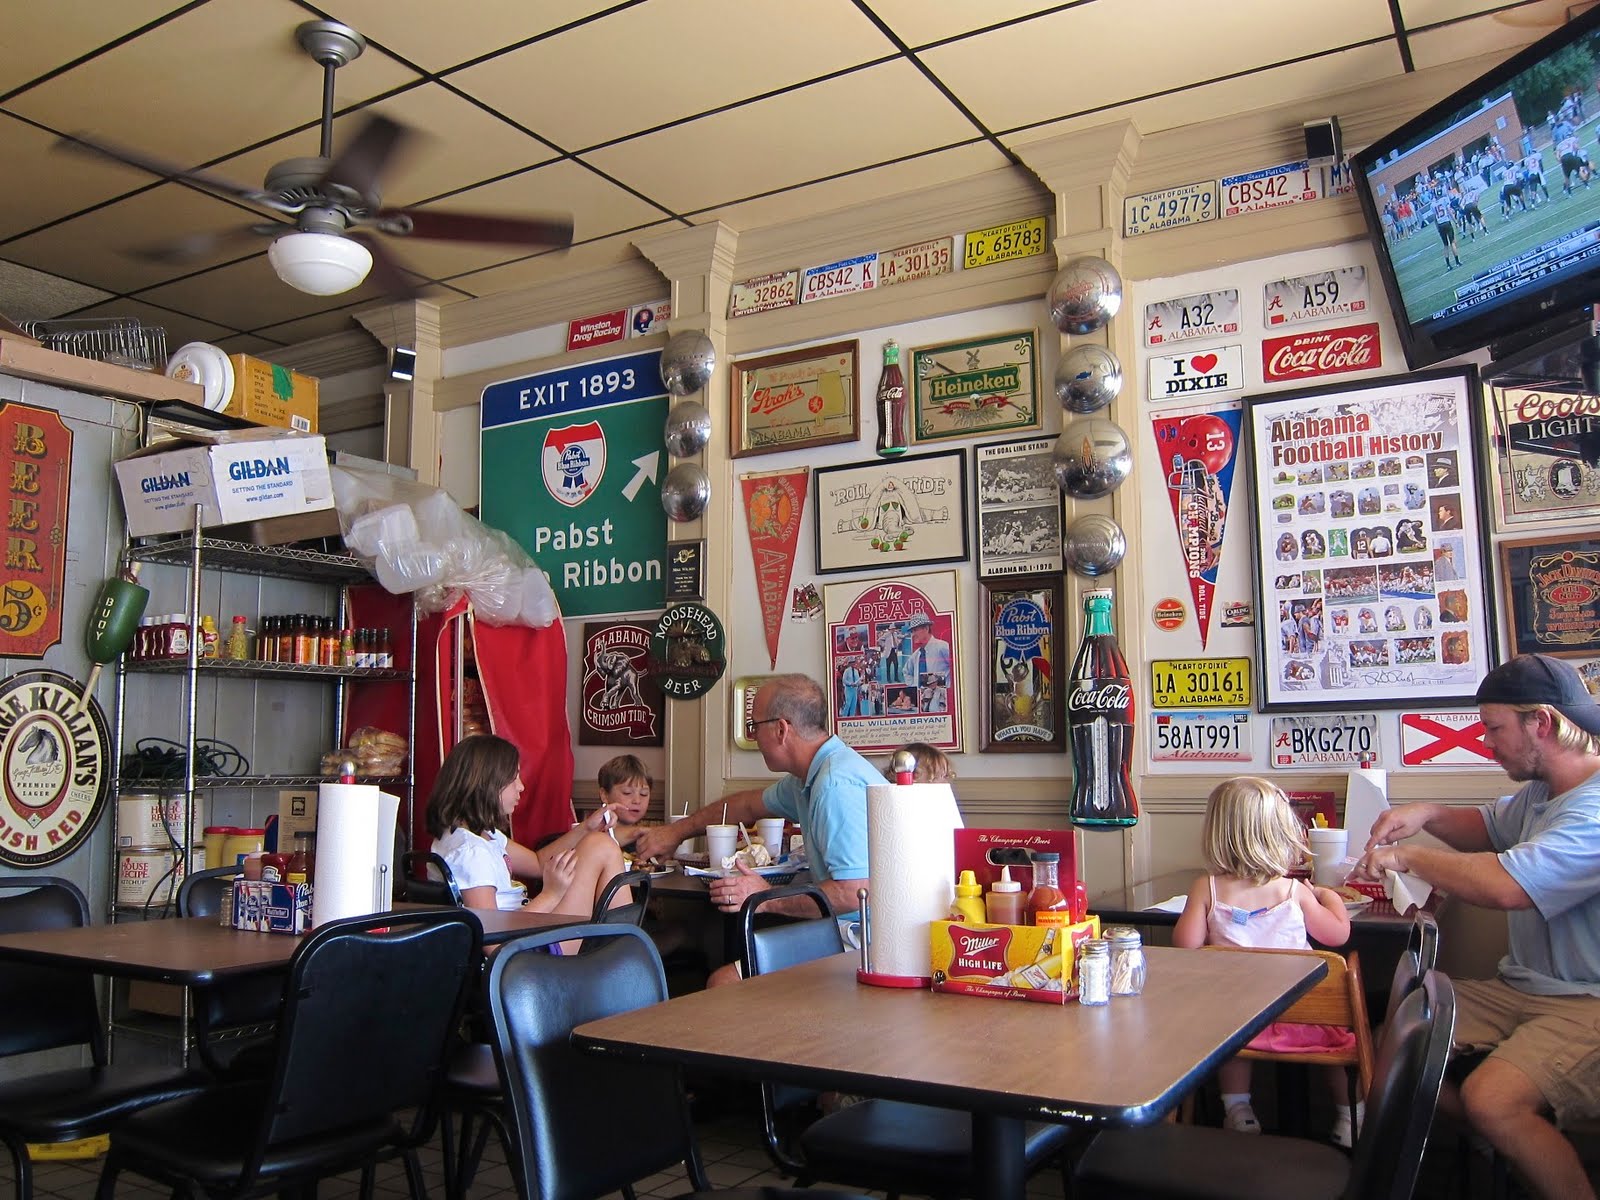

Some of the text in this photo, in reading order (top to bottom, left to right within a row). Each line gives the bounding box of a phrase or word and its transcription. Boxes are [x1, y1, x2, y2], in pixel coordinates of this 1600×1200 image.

[1167, 190, 1176, 198] OF
[1228, 175, 1288, 206] CBS42
[1131, 192, 1211, 225] 1C 49779
[1244, 199, 1294, 213] Alabama
[1003, 227, 1011, 235] OF
[1129, 216, 1191, 235] 76 ALABAMA
[967, 227, 1042, 258] 1C 65783
[985, 249, 1023, 263] ALABAMA
[808, 267, 853, 292] CBS42
[862, 262, 872, 281] K
[897, 270, 931, 284] ALABAMA
[754, 281, 794, 304] 32862
[1303, 281, 1339, 308] A59
[657, 305, 671, 314] DEN
[1181, 303, 1215, 330] A32
[1290, 304, 1344, 321] ALABAMA
[573, 326, 621, 342] Drag Racing
[580, 320, 611, 334] Winston
[1168, 325, 1219, 341] ALABAMA
[1293, 334, 1332, 347] DRINK
[1268, 334, 1373, 377] Coca-Cola
[1173, 359, 1186, 376] I
[519, 368, 636, 411] EXIT 1893
[933, 374, 1016, 398] Heineken
[1166, 373, 1228, 394] DIXIE
[750, 383, 806, 414] Stroh's
[1514, 391, 1600, 423] Coors
[1270, 413, 1370, 443] Alabama
[1527, 416, 1595, 440] LIGHT
[996, 446, 1012, 455] GOAL
[1013, 444, 1027, 453] LINE
[1028, 442, 1049, 451] STAND
[1205, 430, 1225, 452] 13
[1273, 431, 1444, 467] Football History
[228, 456, 291, 482] GILDAN
[140, 471, 191, 494] GILDAN
[232, 480, 294, 495] SETTING THE STANDARD
[4, 421, 47, 572] BEER
[245, 491, 284, 503] www.gildan.com
[535, 518, 613, 553] Pabst
[563, 557, 661, 589] Ribbon
[987, 566, 1018, 575] ALABAMA
[758, 548, 788, 636] ALABAMA
[878, 587, 902, 601] The
[95, 596, 114, 642] BUOY
[858, 598, 926, 624] BEAR
[1006, 606, 1038, 623] Pabst
[1199, 603, 1207, 620] TIDE
[655, 606, 717, 640] MOOSEHEAD
[995, 624, 1050, 637] Blue Ribbon
[594, 630, 652, 651] ALABAMA
[1197, 662, 1207, 670] OF
[664, 678, 702, 695] BEER
[1156, 671, 1244, 693] 1A 30161
[1068, 684, 1130, 711] Coca-Cola
[1179, 694, 1244, 703] ALABAMA 75
[587, 708, 647, 726] CRIMSON TIDE
[867, 718, 907, 727] WILLIAM
[909, 716, 948, 725] BRYANT
[1434, 714, 1480, 722] ALABAMA
[1019, 725, 1031, 733] YOU
[1158, 725, 1240, 749] 58AT991
[1292, 726, 1371, 754] BKG270
[1162, 750, 1240, 759] Alabama
[1299, 752, 1354, 763] ALABAMA
[70, 791, 92, 802] CHEERS
[46, 810, 82, 846] RED
[977, 834, 1051, 845] The Champagne of Beers
[121, 862, 149, 871] HOUSE
[960, 935, 1000, 956] Miller
[958, 957, 1003, 970] HIGH LIFE
[964, 985, 1026, 998] The Champagne of Beers
